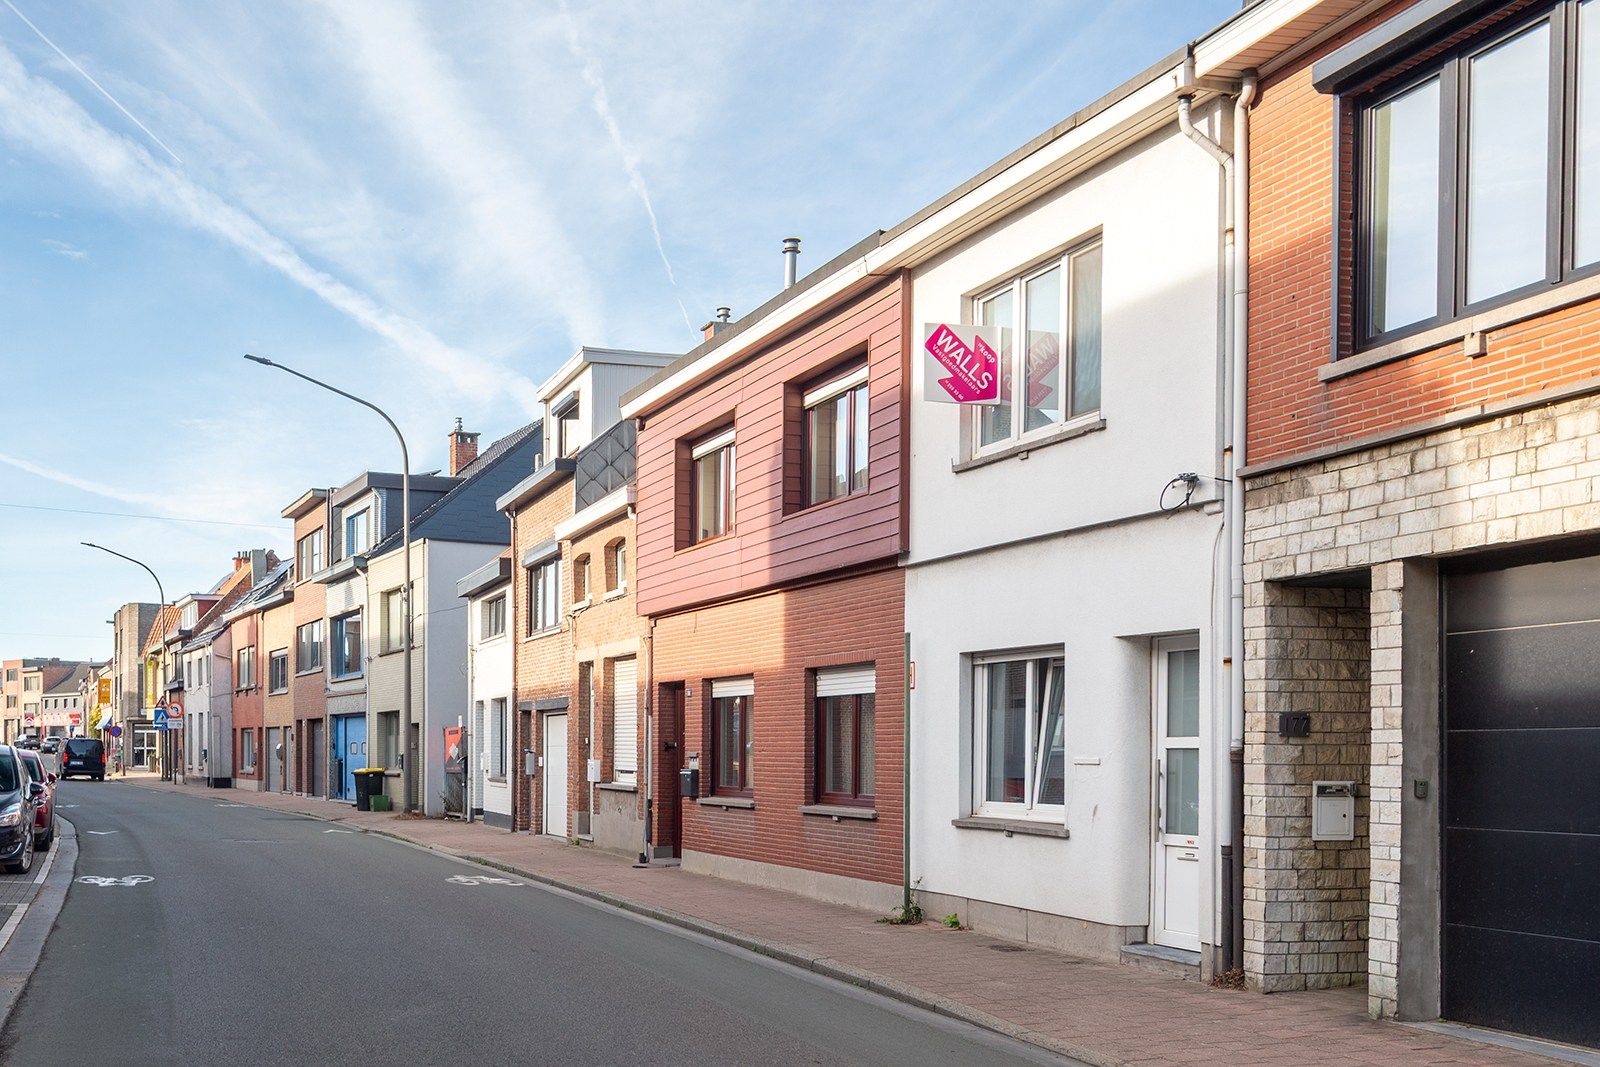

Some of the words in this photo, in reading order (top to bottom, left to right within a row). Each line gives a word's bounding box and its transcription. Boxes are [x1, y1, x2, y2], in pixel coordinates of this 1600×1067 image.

[932, 344, 981, 395] Vastgoedmakelaars
[937, 329, 993, 390] WALLS
[980, 345, 995, 364] koop
[1285, 717, 1308, 731] 177
